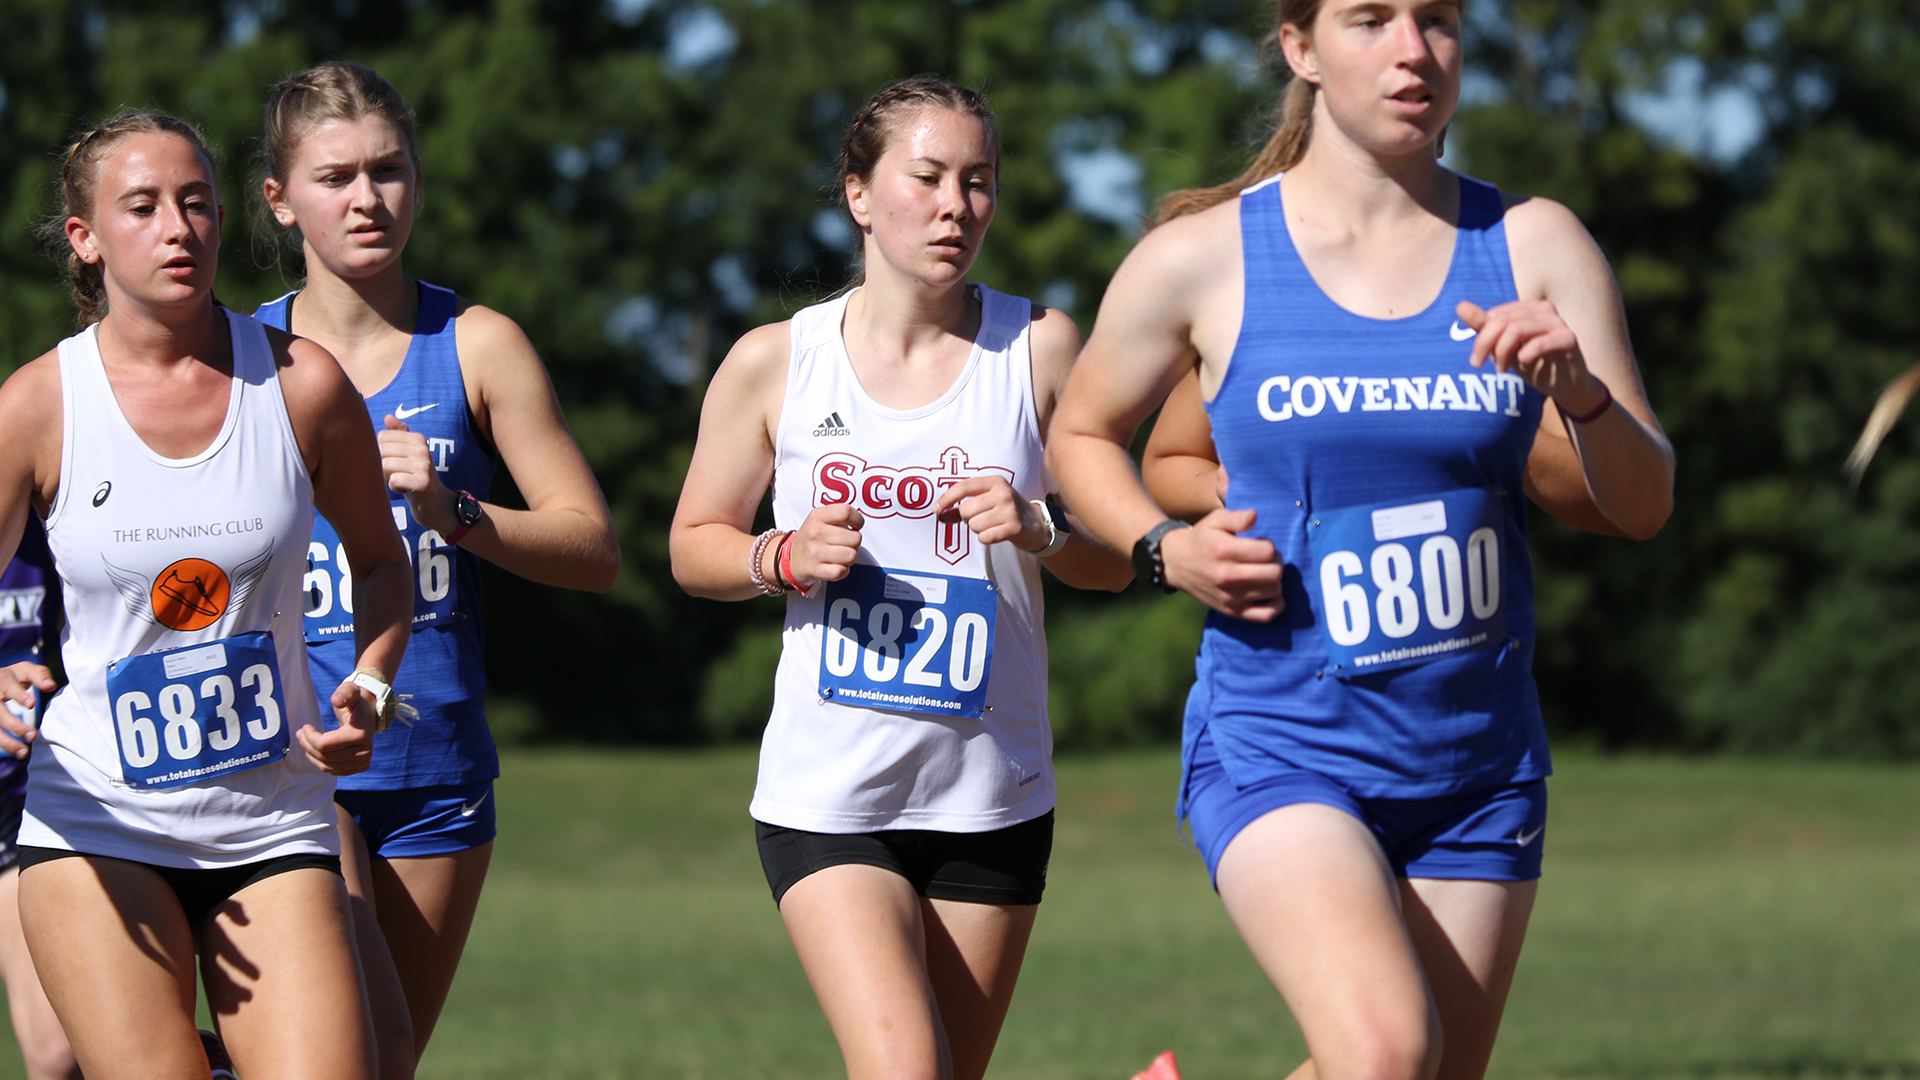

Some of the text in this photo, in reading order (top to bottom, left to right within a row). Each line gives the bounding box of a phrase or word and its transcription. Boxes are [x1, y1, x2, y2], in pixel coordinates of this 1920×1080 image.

[1256, 373, 1525, 422] COVENANT
[812, 426, 851, 438] adidas
[113, 517, 264, 543] THE RUNNING CLUB
[1319, 526, 1500, 647] 6800
[824, 597, 989, 692] 6820
[1353, 631, 1488, 667] www.totalracesolutions.com
[115, 663, 282, 769] 6833
[837, 687, 962, 710] www.totalracesolutions.com
[146, 750, 270, 785] www.totalracesolutions.com
